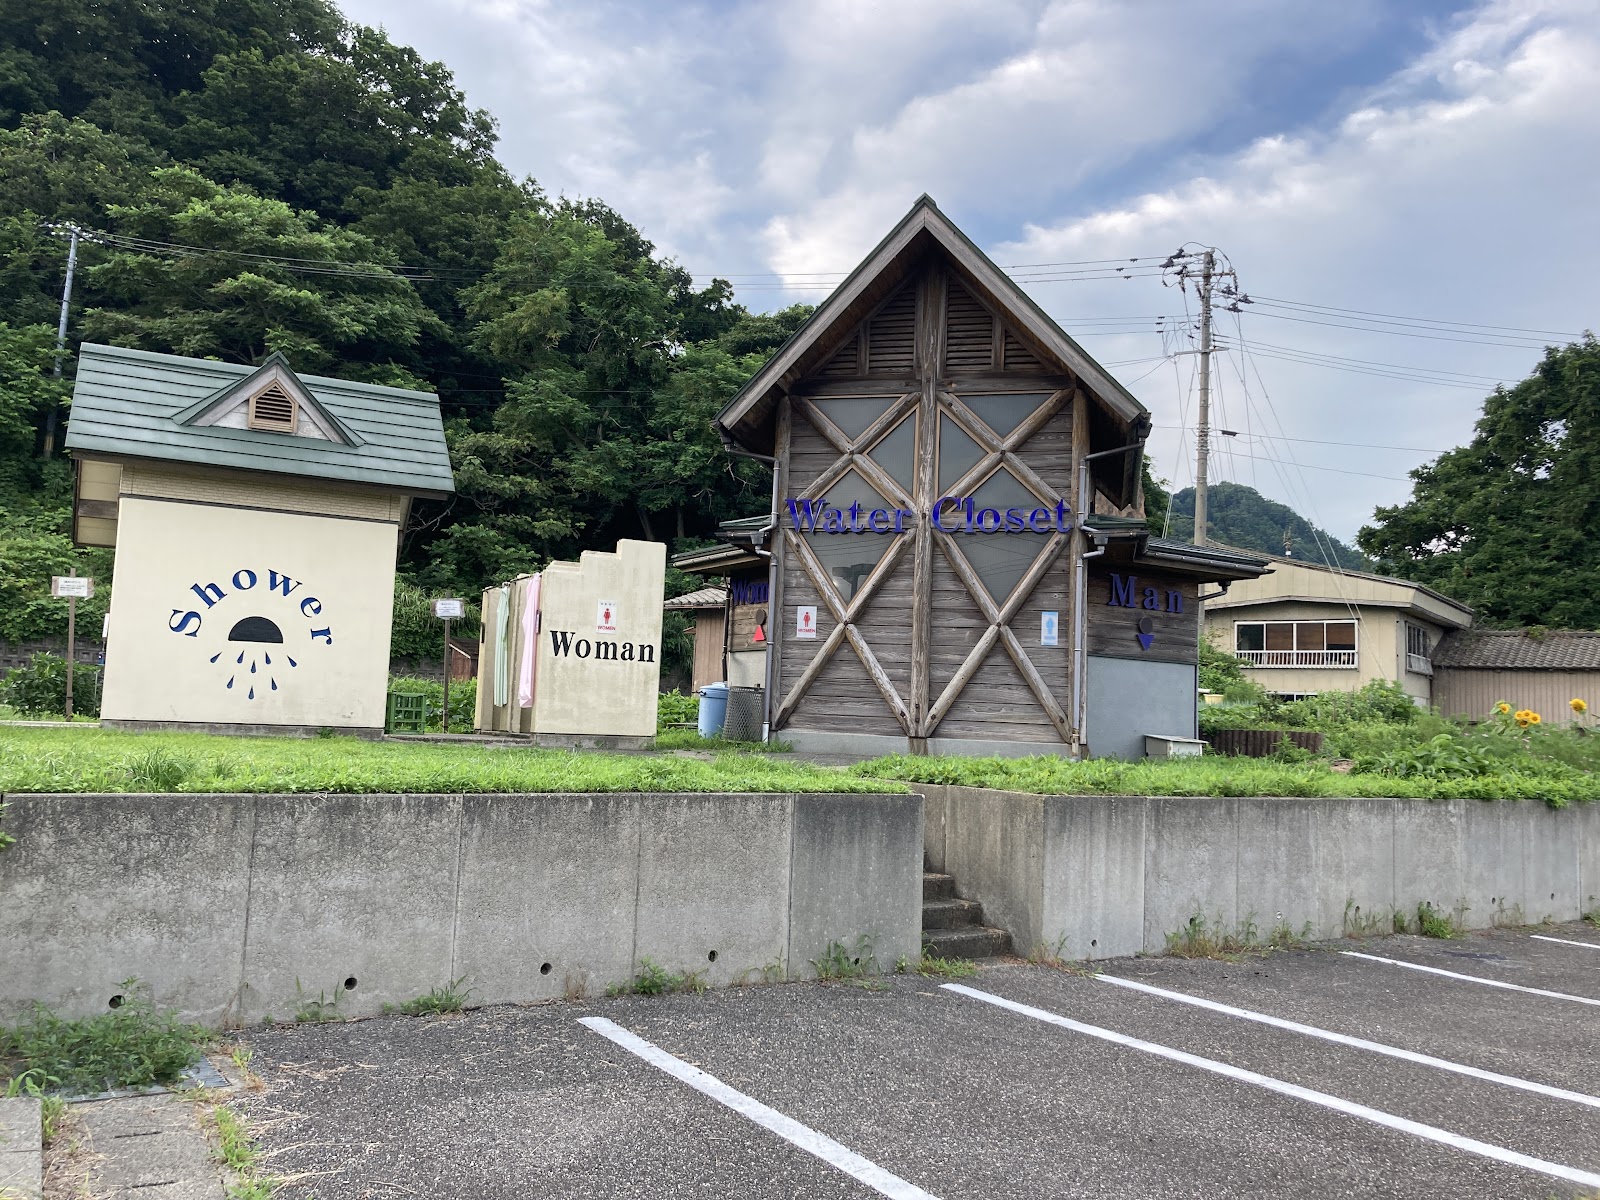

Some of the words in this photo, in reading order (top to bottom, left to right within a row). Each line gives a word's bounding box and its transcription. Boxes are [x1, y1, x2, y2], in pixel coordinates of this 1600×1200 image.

[786, 497, 913, 533] Water
[931, 496, 1073, 533] Closet
[168, 569, 333, 646] Shower
[1107, 573, 1184, 613] Man
[550, 630, 655, 662] Woman
